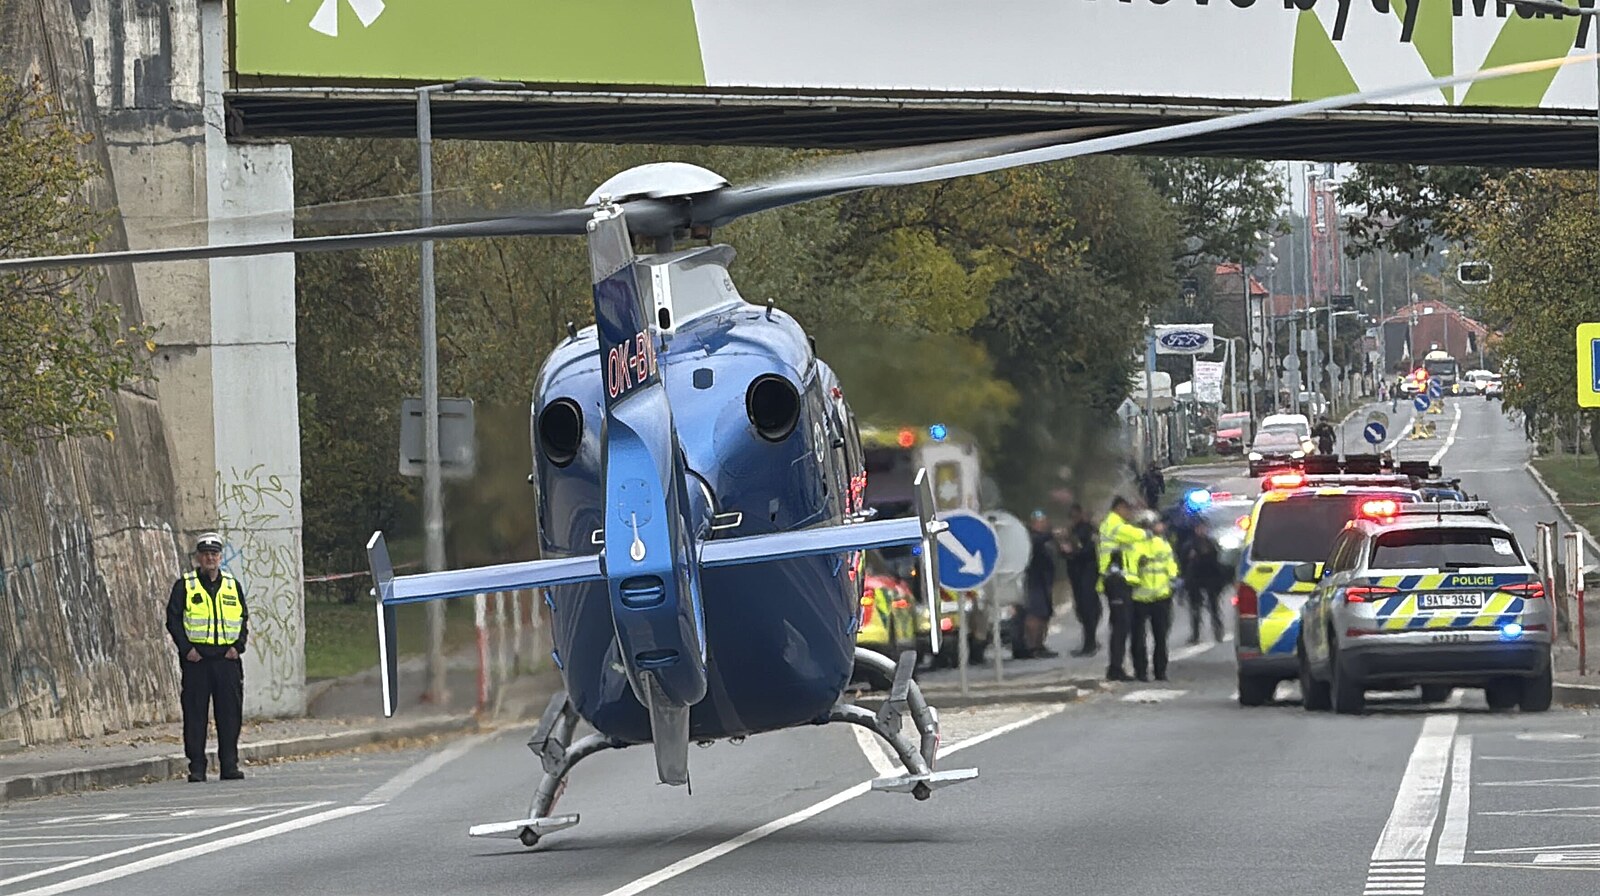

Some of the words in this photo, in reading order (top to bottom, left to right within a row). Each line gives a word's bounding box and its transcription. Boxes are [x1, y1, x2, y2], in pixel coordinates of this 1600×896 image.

[1452, 576, 1494, 585] POLICIE
[1426, 595, 1444, 605] 9AT
[1452, 594, 1476, 605] 3946
